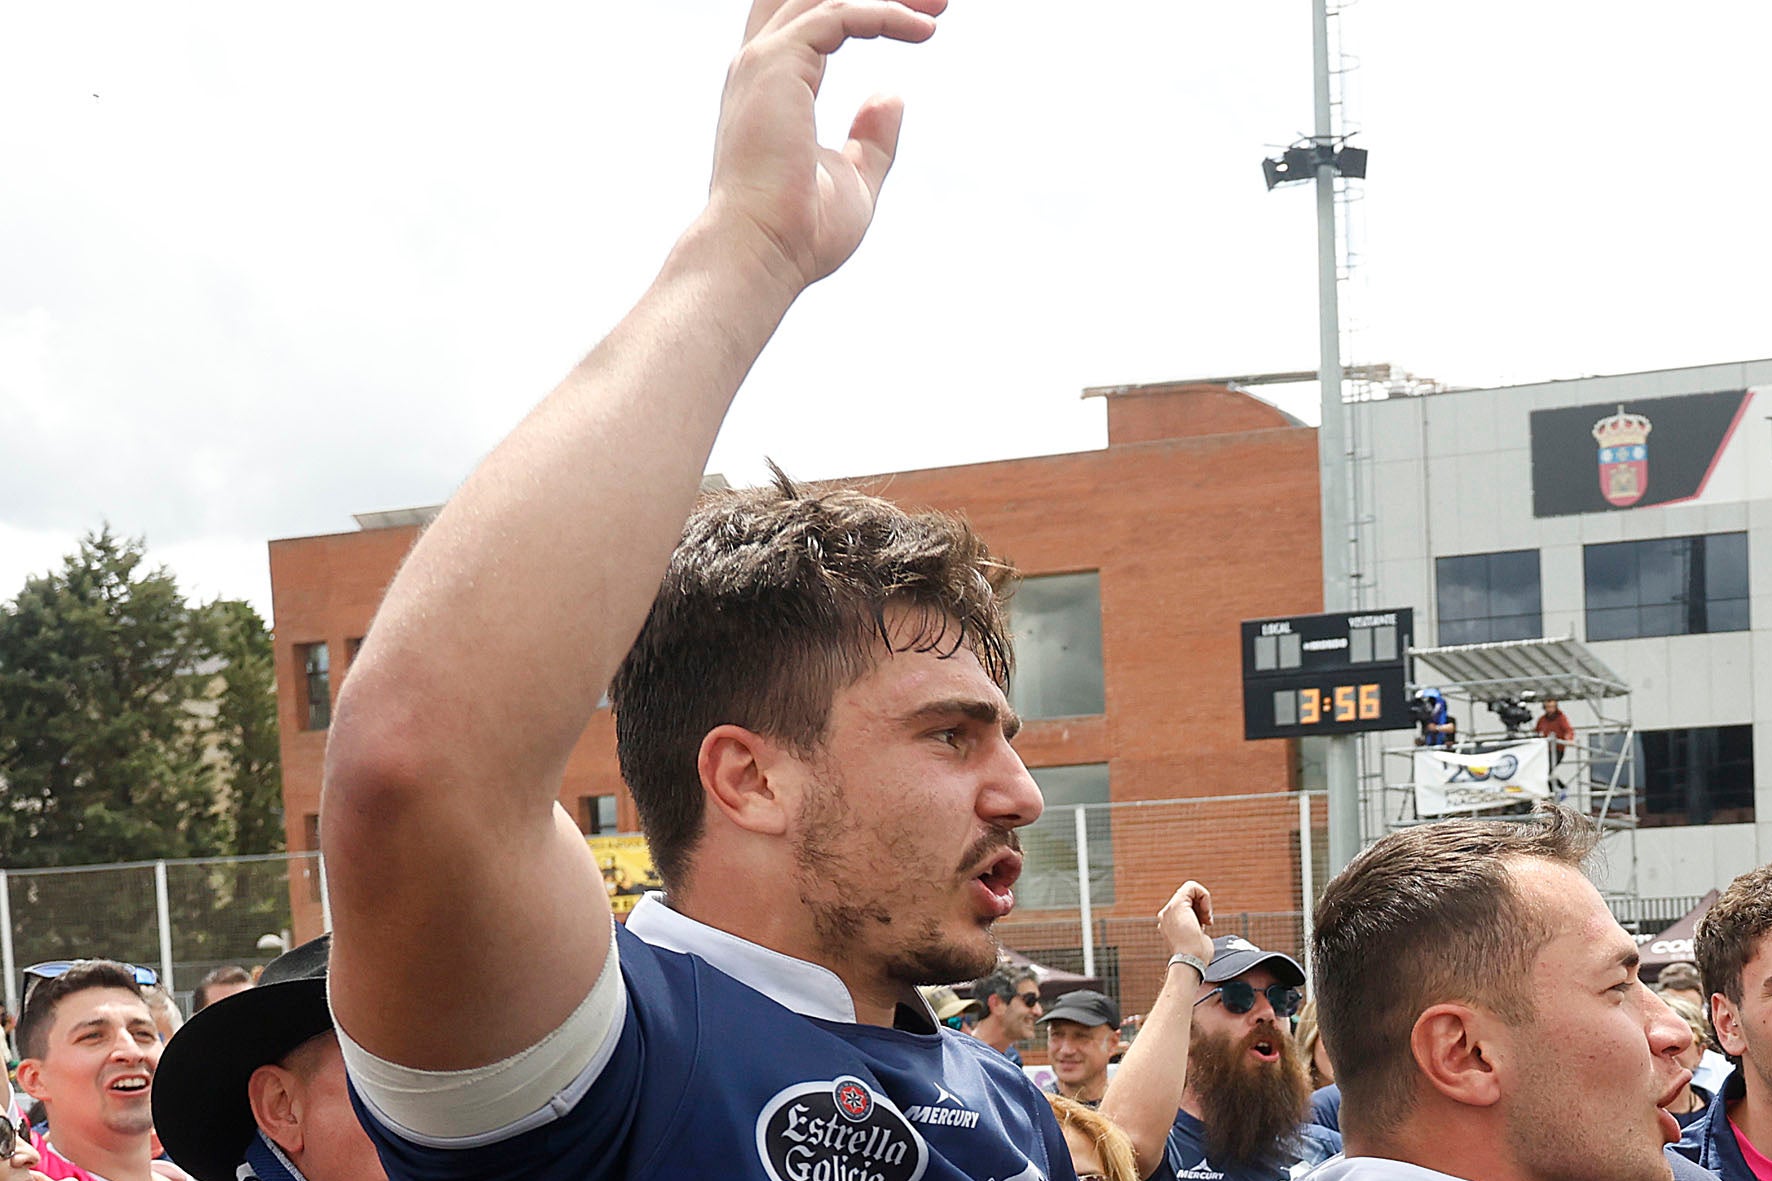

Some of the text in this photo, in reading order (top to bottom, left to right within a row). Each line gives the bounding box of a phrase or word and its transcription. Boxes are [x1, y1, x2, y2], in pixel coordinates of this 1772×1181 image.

[1300, 683, 1381, 724] 3:56
[904, 1105, 980, 1129] MERCURY
[781, 1103, 907, 1166] Estrella
[1176, 1169, 1225, 1180] MERCURY
